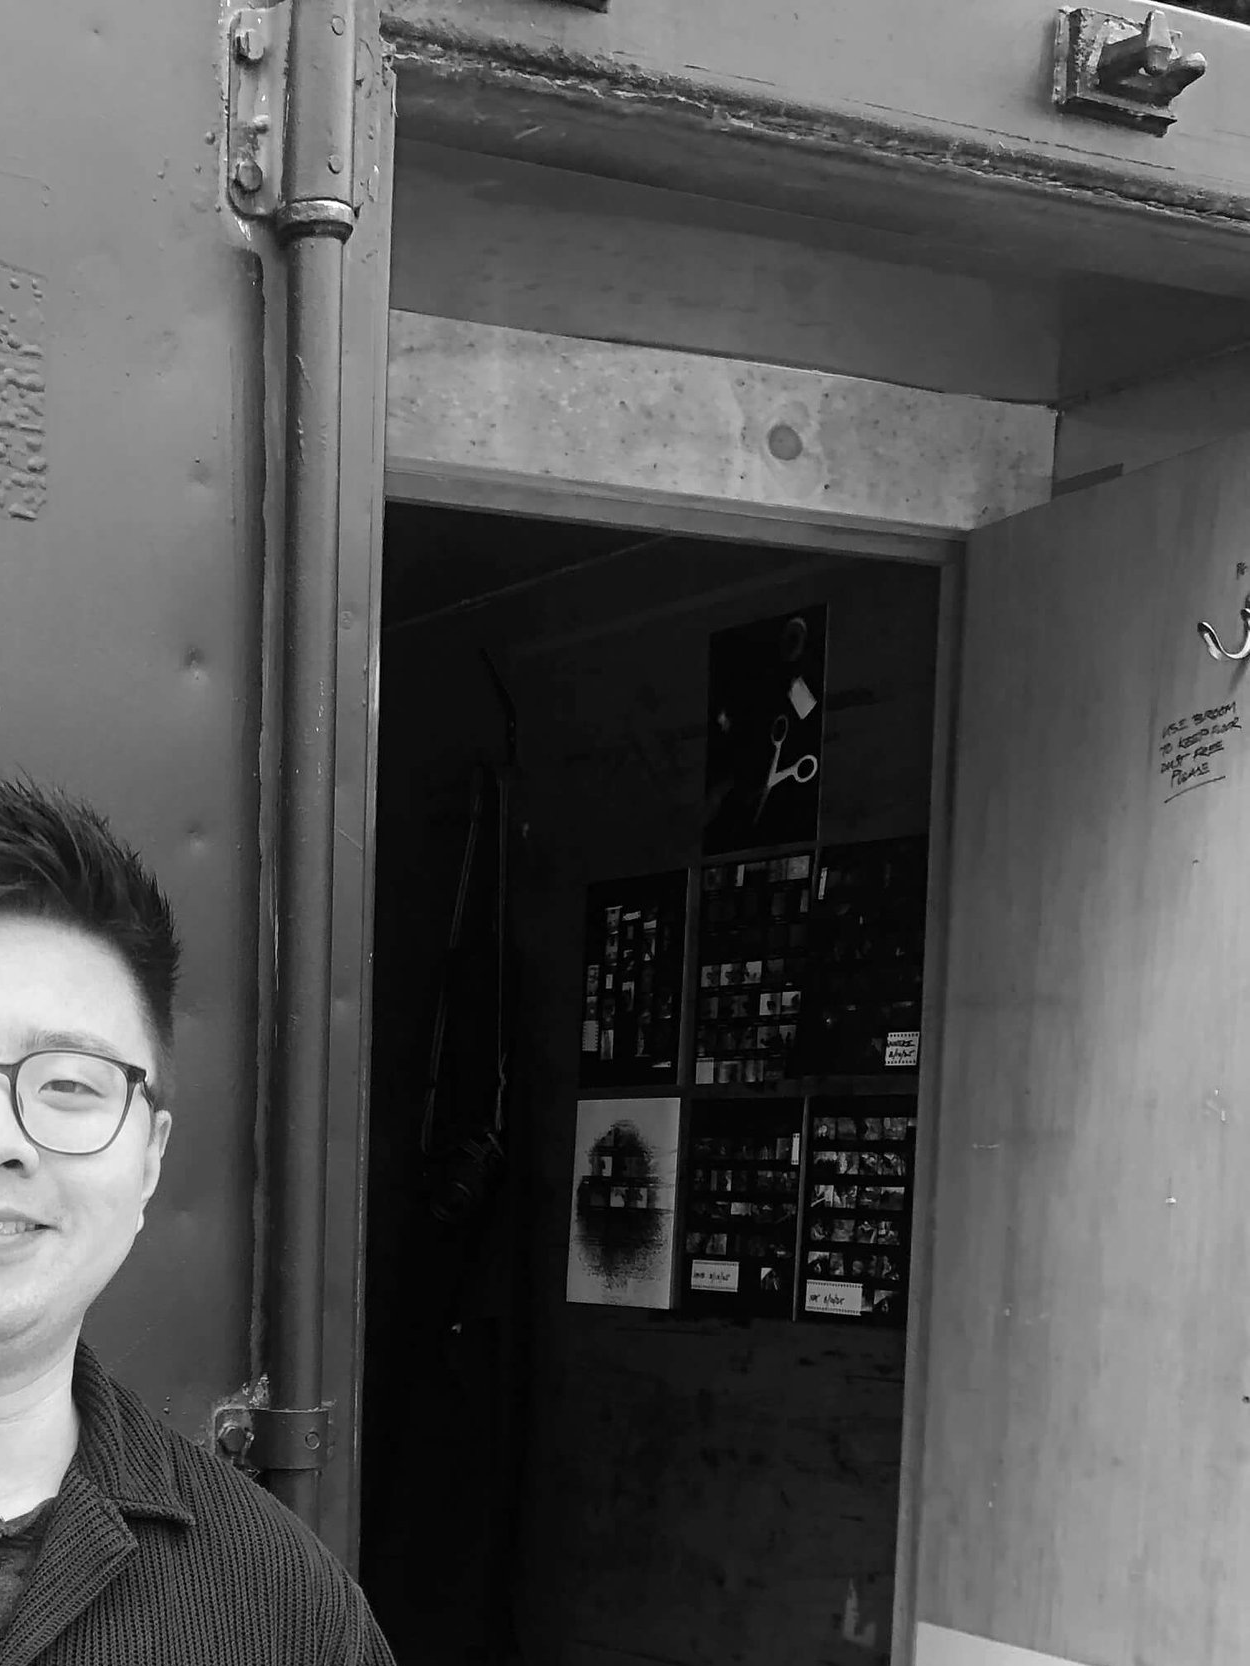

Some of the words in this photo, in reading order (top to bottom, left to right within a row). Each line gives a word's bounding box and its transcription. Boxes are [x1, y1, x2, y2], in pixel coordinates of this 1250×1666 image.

[1162, 718, 1188, 739] USE
[1191, 701, 1236, 726] BROOM
[1178, 728, 1210, 749] KEEP
[1160, 753, 1191, 774] DUST
[1193, 740, 1224, 761] FREE
